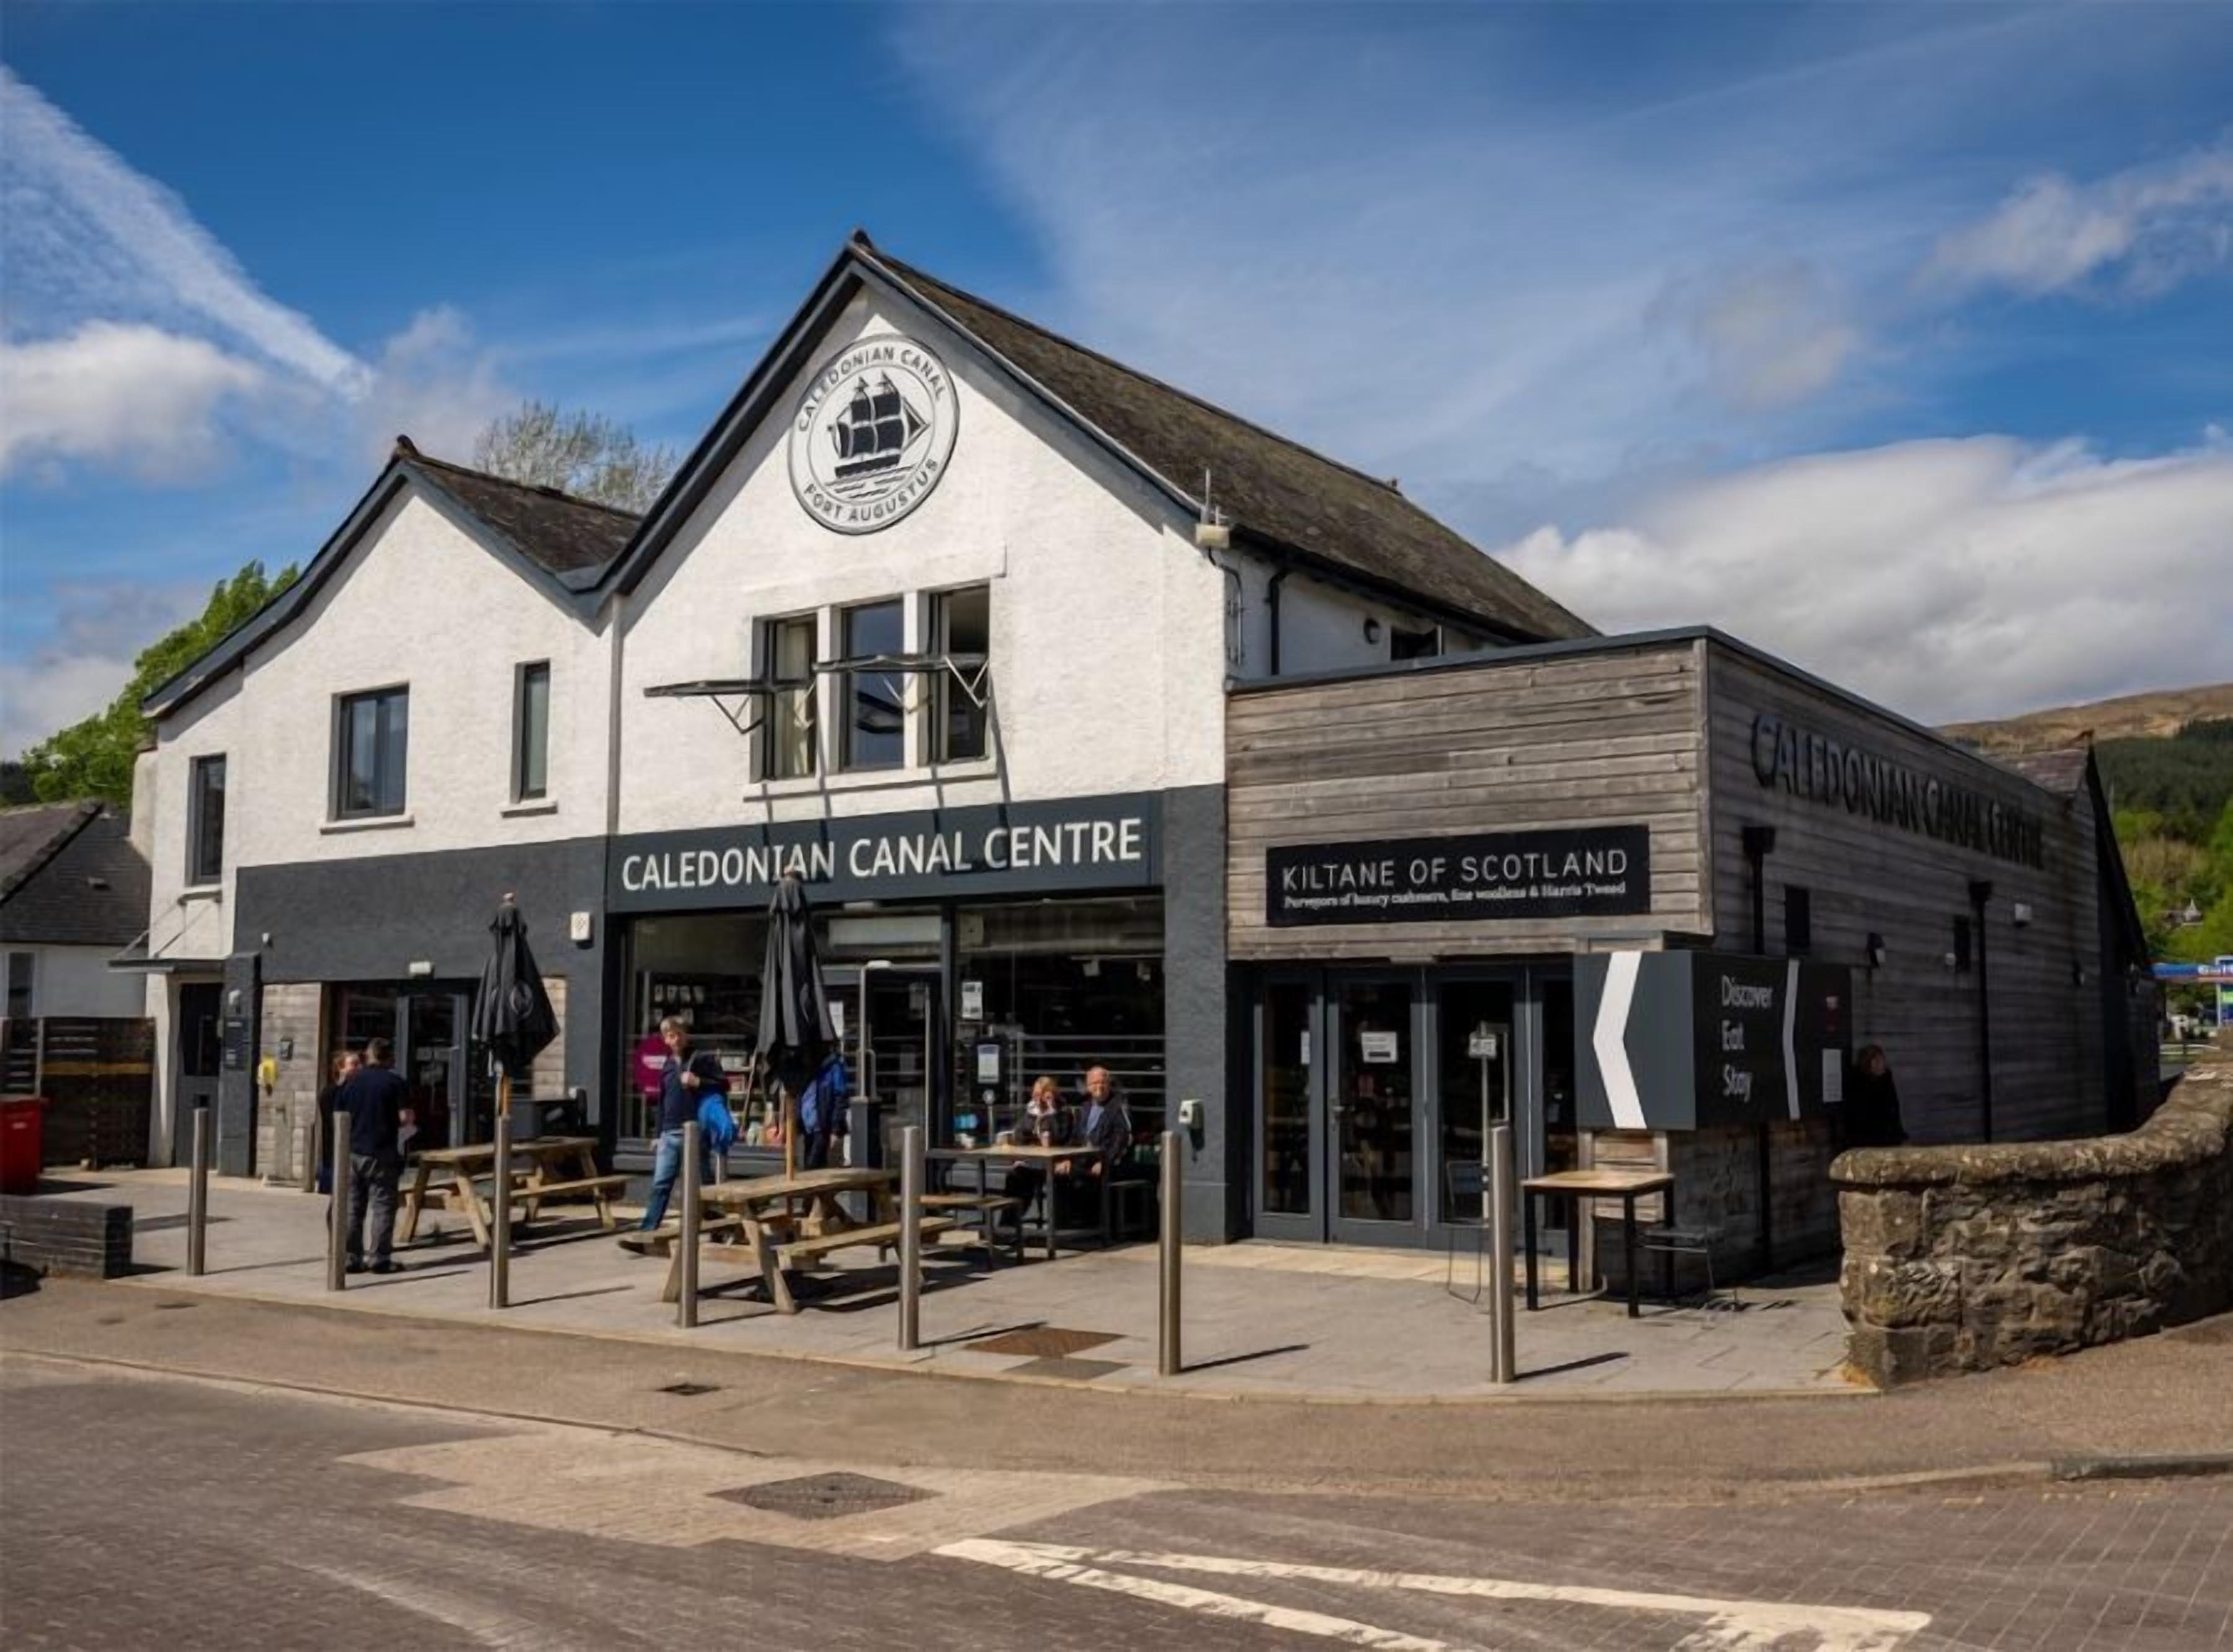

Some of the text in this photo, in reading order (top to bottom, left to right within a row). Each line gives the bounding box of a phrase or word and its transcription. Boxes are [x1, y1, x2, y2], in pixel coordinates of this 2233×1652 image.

[798, 346, 946, 432] CALEDONIAN CANAL
[848, 460, 938, 521] AUGUSTUS
[622, 818, 1142, 892] CALEDONIAN CANAL CENTRE
[1282, 848, 1628, 891] KILTANE OF SCOTLAND
[1721, 974, 1773, 1008] Discover
[1721, 1019, 1745, 1051] Eat
[1722, 1064, 1754, 1103] Stay
